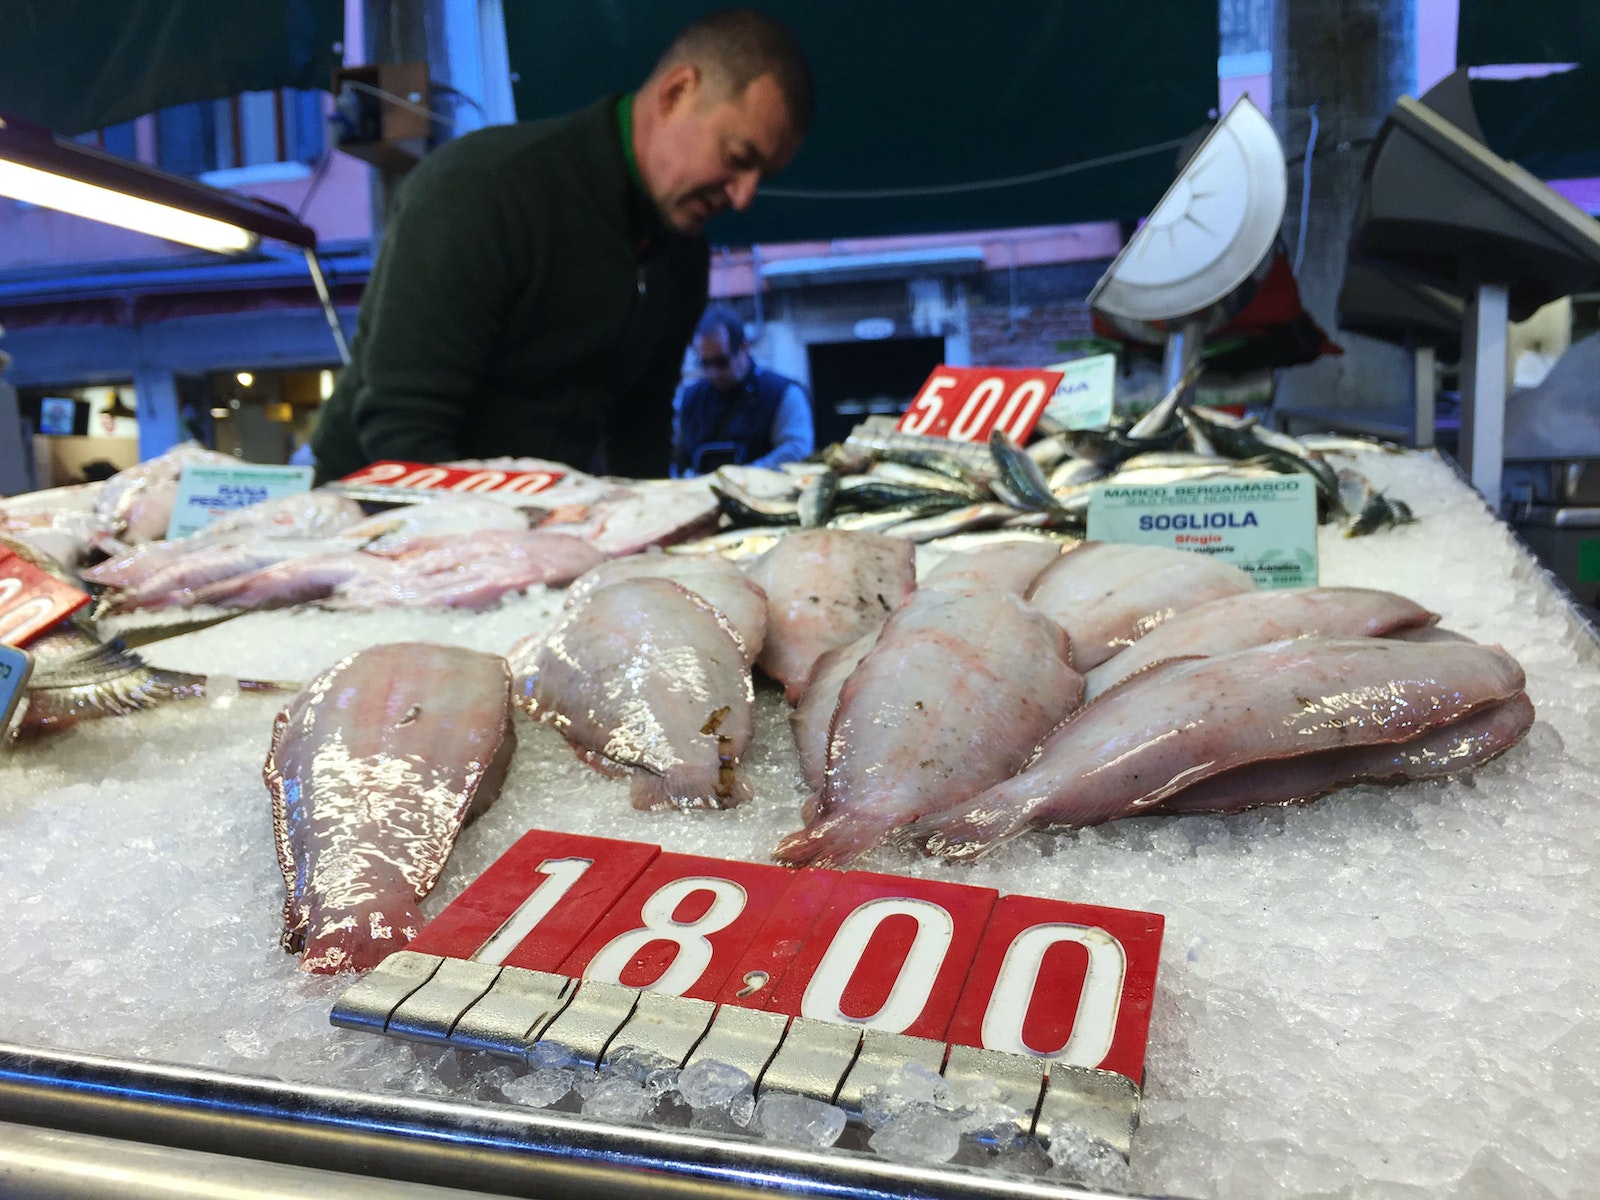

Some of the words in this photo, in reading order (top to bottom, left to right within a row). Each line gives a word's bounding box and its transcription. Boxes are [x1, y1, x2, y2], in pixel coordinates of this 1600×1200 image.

[1104, 486, 1167, 499] MARCO
[1175, 480, 1300, 496] BERGAMASCO
[1139, 511, 1258, 531] SOGLIOLA
[471, 855, 1129, 1069] 18,00
